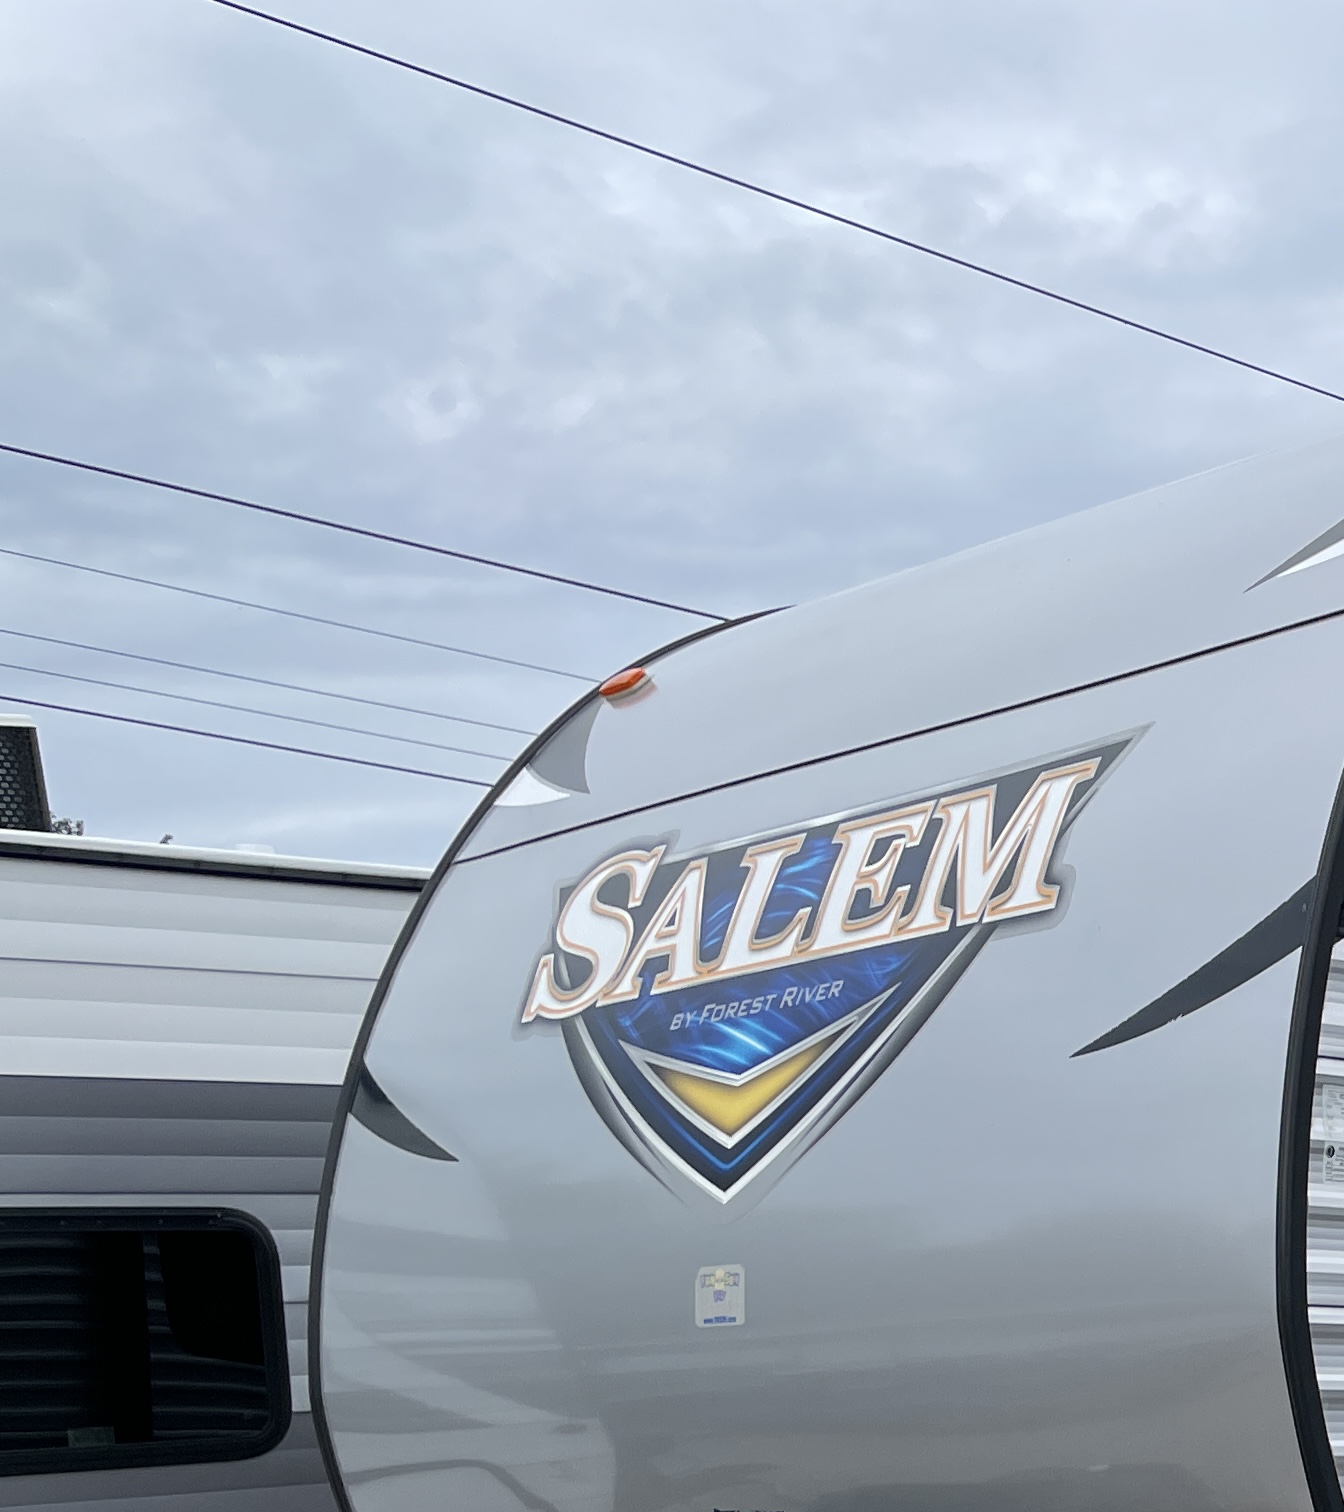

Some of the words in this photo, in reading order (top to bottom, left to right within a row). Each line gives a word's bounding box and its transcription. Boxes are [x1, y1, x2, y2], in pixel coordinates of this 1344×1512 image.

[522, 757, 1103, 1024] SALEM
[669, 1010, 694, 1031] BY
[697, 993, 777, 1026] FOREST
[779, 979, 844, 1012] RIVER
